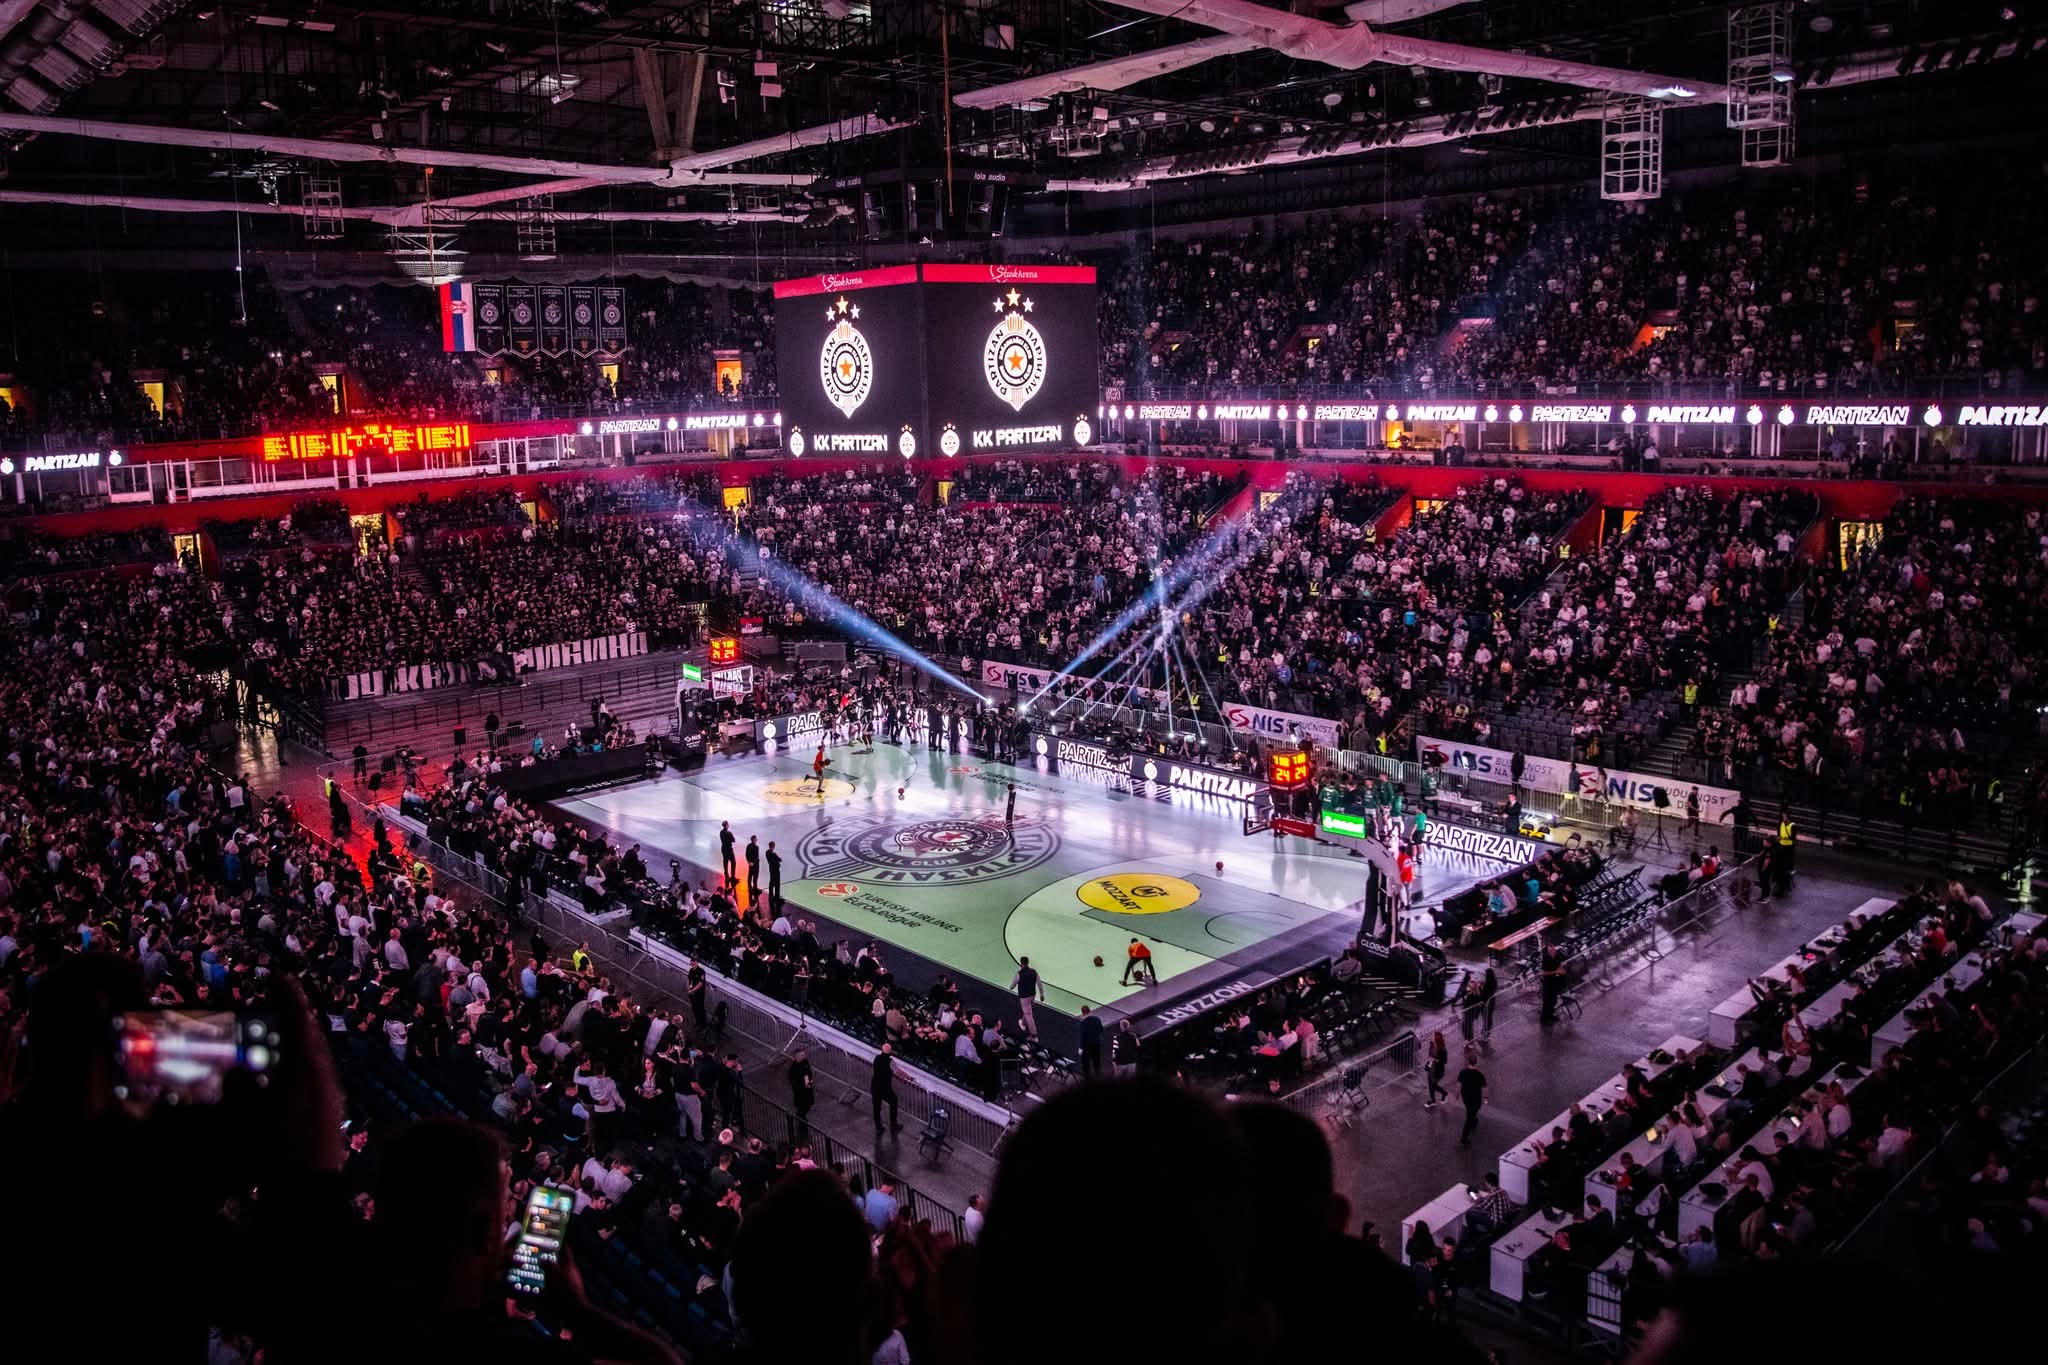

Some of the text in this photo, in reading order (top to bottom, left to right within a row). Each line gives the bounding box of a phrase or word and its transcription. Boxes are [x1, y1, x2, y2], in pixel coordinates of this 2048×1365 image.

[823, 337, 840, 402] PARTIZAN
[987, 329, 1008, 396] PARTIZAN
[686, 415, 747, 428] PARTIZAN
[1139, 406, 1191, 419] PARTIZAN
[1215, 406, 1270, 420] PARTIZAN
[1315, 406, 1378, 420] PARTIZAN
[1407, 406, 1476, 421] PARTIZAN
[1532, 406, 1611, 422] PARTIZAN
[1647, 406, 1735, 423] PARTIZAN
[1807, 406, 1909, 425] PARTIZAN
[600, 419, 660, 433] PARTIZAN
[814, 434, 888, 452] KK PARTIZAN
[974, 425, 1062, 448] KK PARTIZAN
[24, 454, 100, 472] PARTIZAN
[1252, 713, 1286, 734] NIS
[1276, 765, 1306, 783] 24 24
[1169, 766, 1257, 801] PARTIZAN
[1608, 777, 1656, 803] NIS
[1424, 820, 1536, 864] PARTIZAN
[910, 857, 960, 867] CLUB
[1097, 880, 1143, 911] MOZZART
[843, 895, 923, 929] EuroLeague
[860, 892, 963, 934] TURKISH AIRLINES
[1159, 981, 1255, 1026] MOZZART
